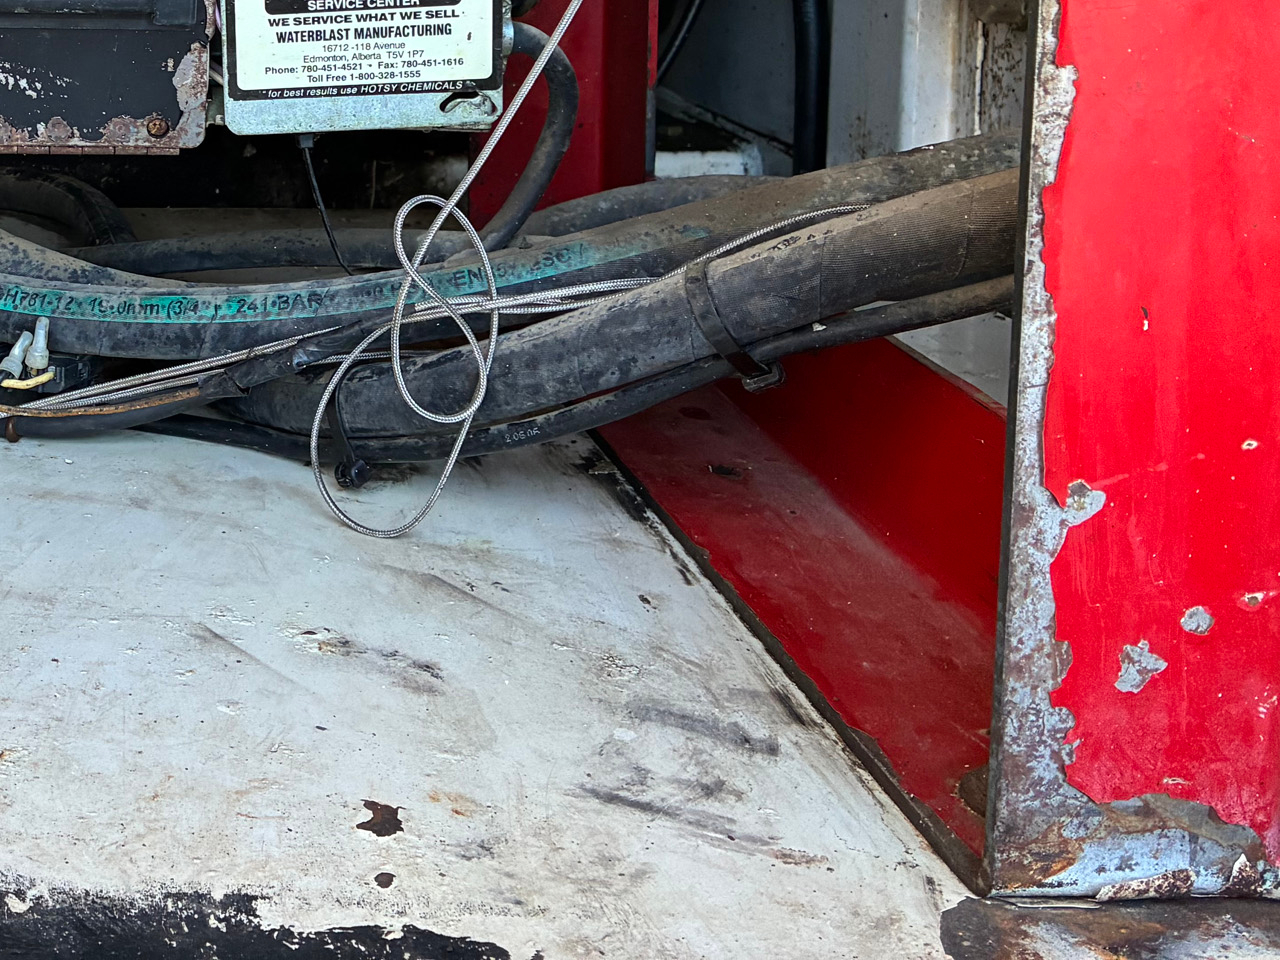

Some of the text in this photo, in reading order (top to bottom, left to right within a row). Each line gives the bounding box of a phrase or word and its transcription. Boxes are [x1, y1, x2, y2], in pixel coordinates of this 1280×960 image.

[268, 9, 460, 27] WE SERVICE WHAT WE SELL
[276, 23, 452, 44] WATERBLAST MANUFACTURING
[322, 43, 350, 53] 16712
[373, 41, 406, 50] Avenue
[303, 49, 425, 64] Edmonton, Alberta T5V 1P7
[264, 58, 464, 75] Phone: 780-451-4521 Fax: 780-451-1616
[307, 70, 421, 83] Toll Free 1-800-328-1555
[283, 88, 304, 97] best
[306, 87, 338, 96] results
[340, 87, 358, 95] use
[360, 83, 398, 94] HOTSY
